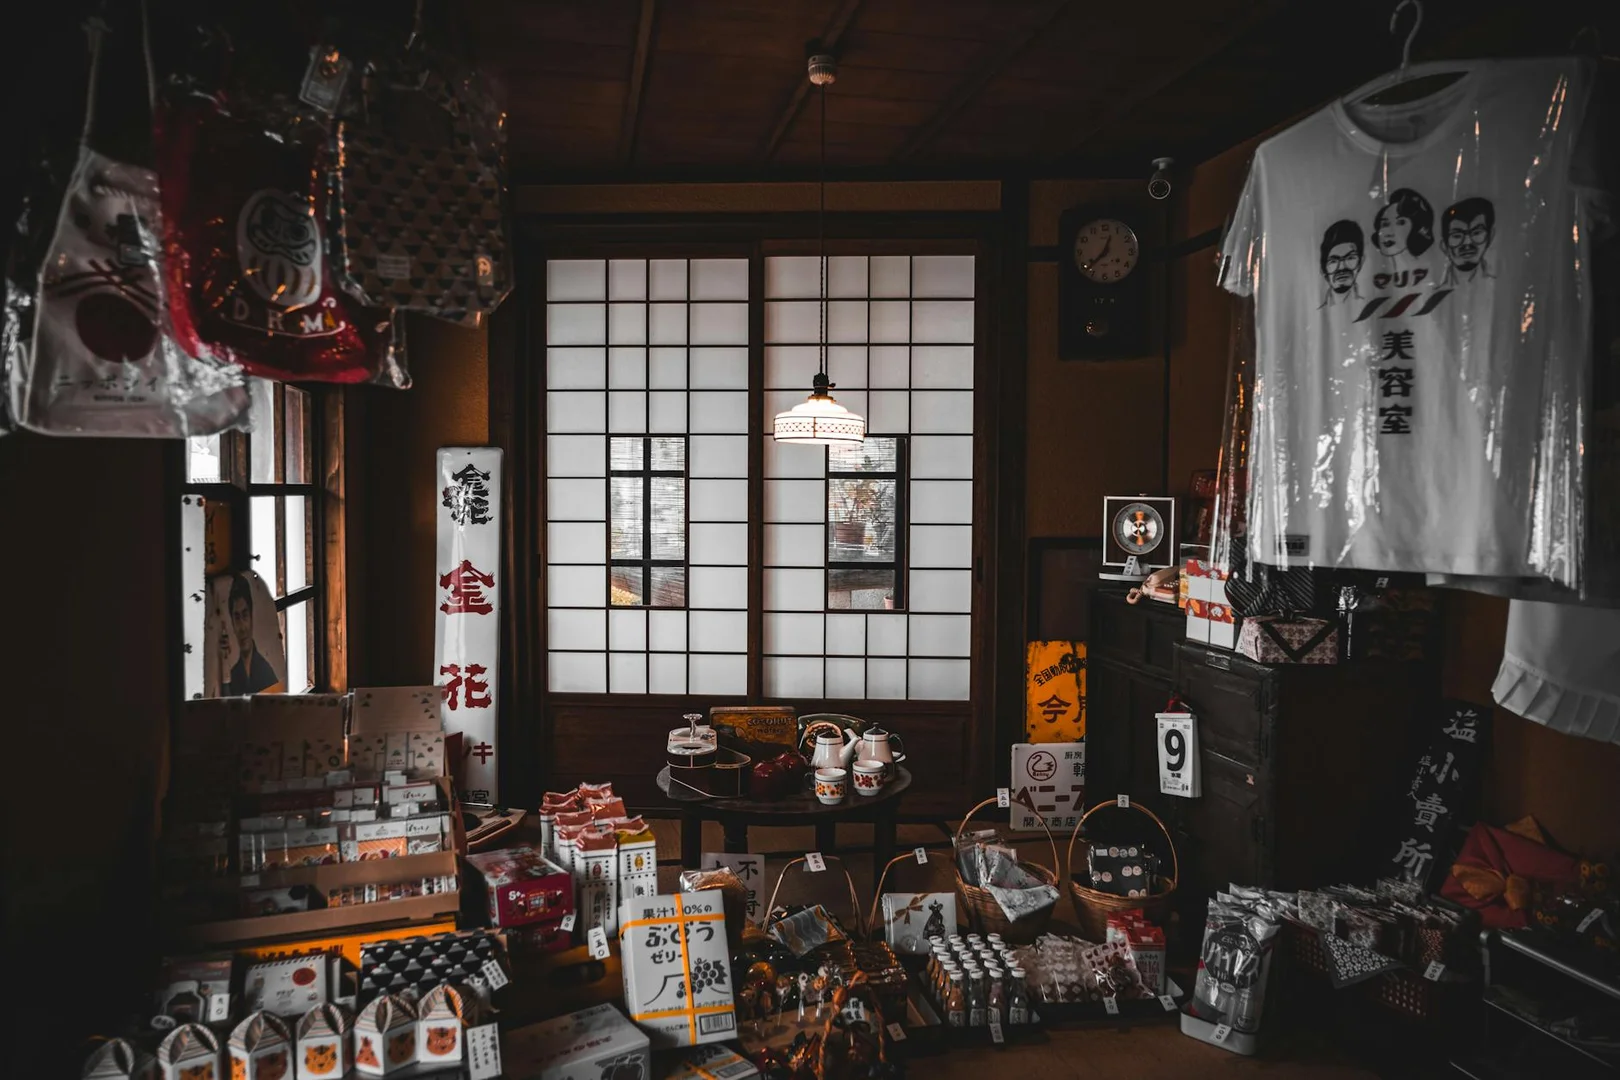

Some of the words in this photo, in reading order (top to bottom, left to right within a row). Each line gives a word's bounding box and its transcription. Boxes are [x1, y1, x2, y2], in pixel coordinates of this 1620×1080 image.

[1373, 268, 1428, 290] マリア
[1379, 329, 1414, 434] 美容室
[1164, 728, 1186, 771] 9
[643, 904, 712, 920] 果汁10%の
[645, 920, 714, 948] ぶどう
